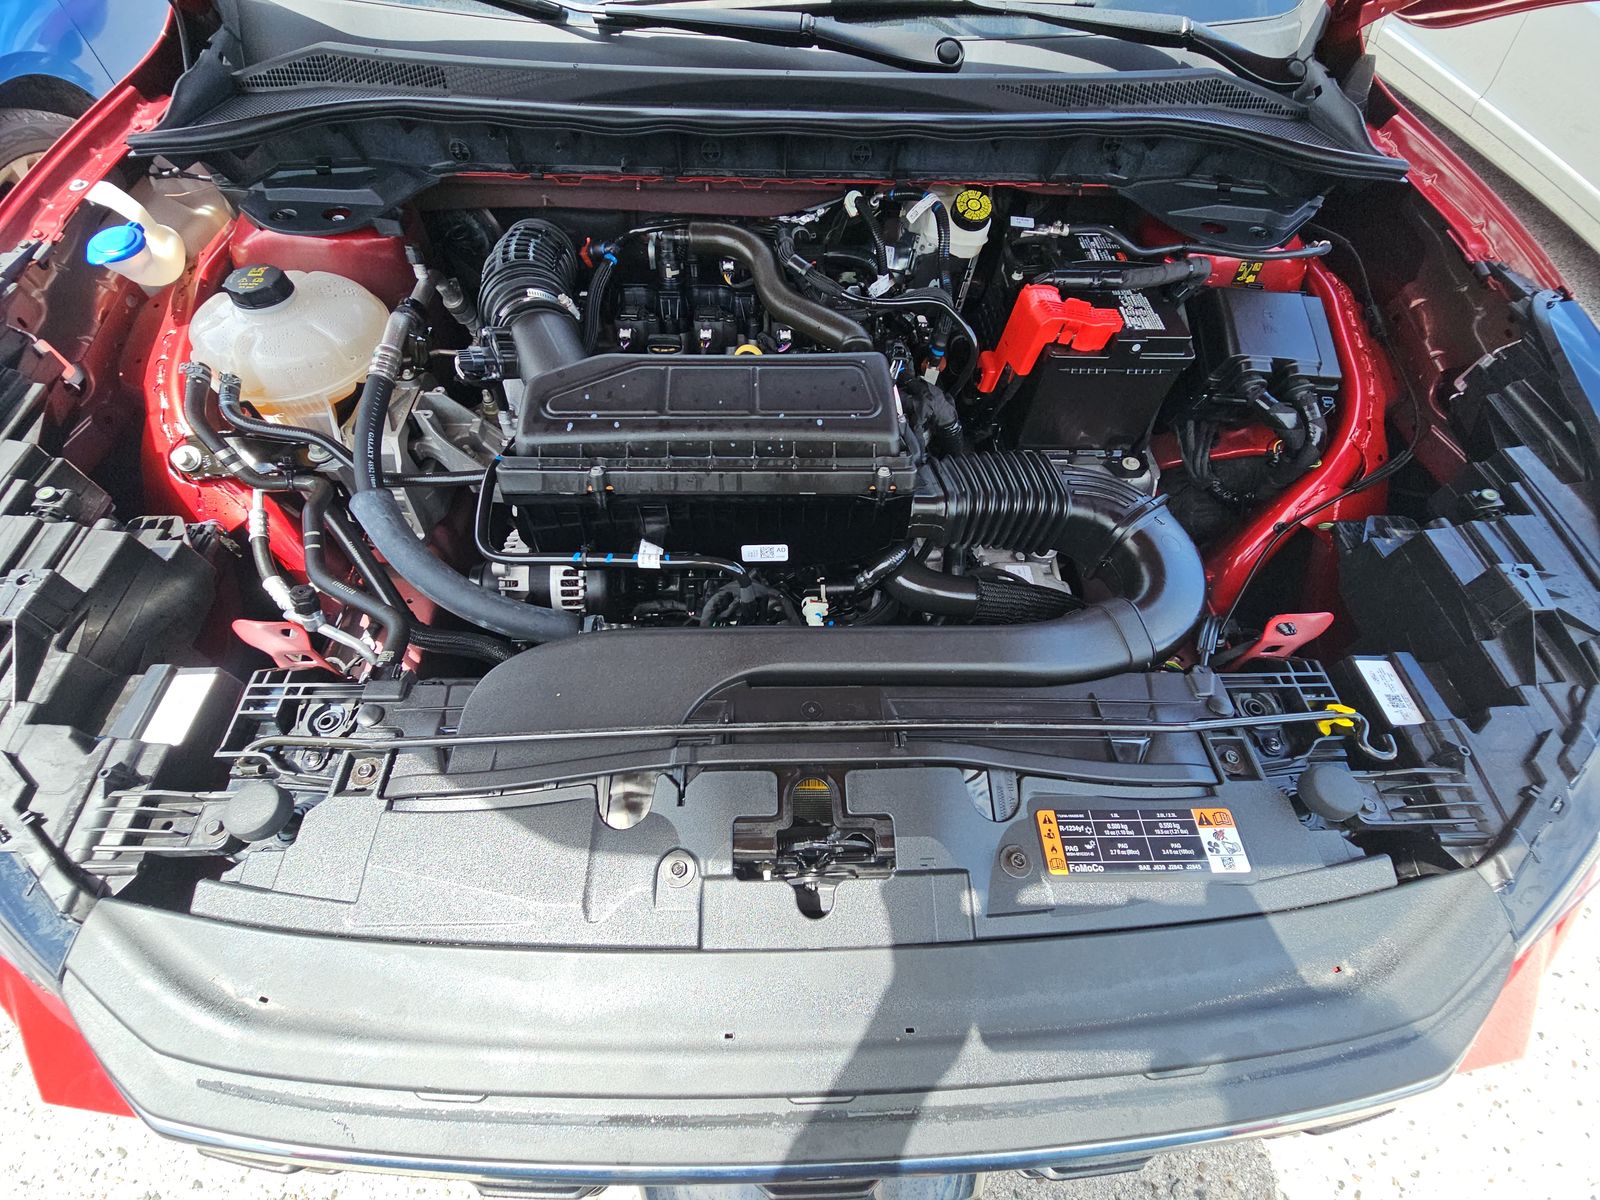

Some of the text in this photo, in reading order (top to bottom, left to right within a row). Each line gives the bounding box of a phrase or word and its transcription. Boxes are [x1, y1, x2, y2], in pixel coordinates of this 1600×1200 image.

[1120, 823, 1128, 831] kg
[1172, 822, 1180, 830] kg
[1069, 863, 1104, 873] FoMoCo
